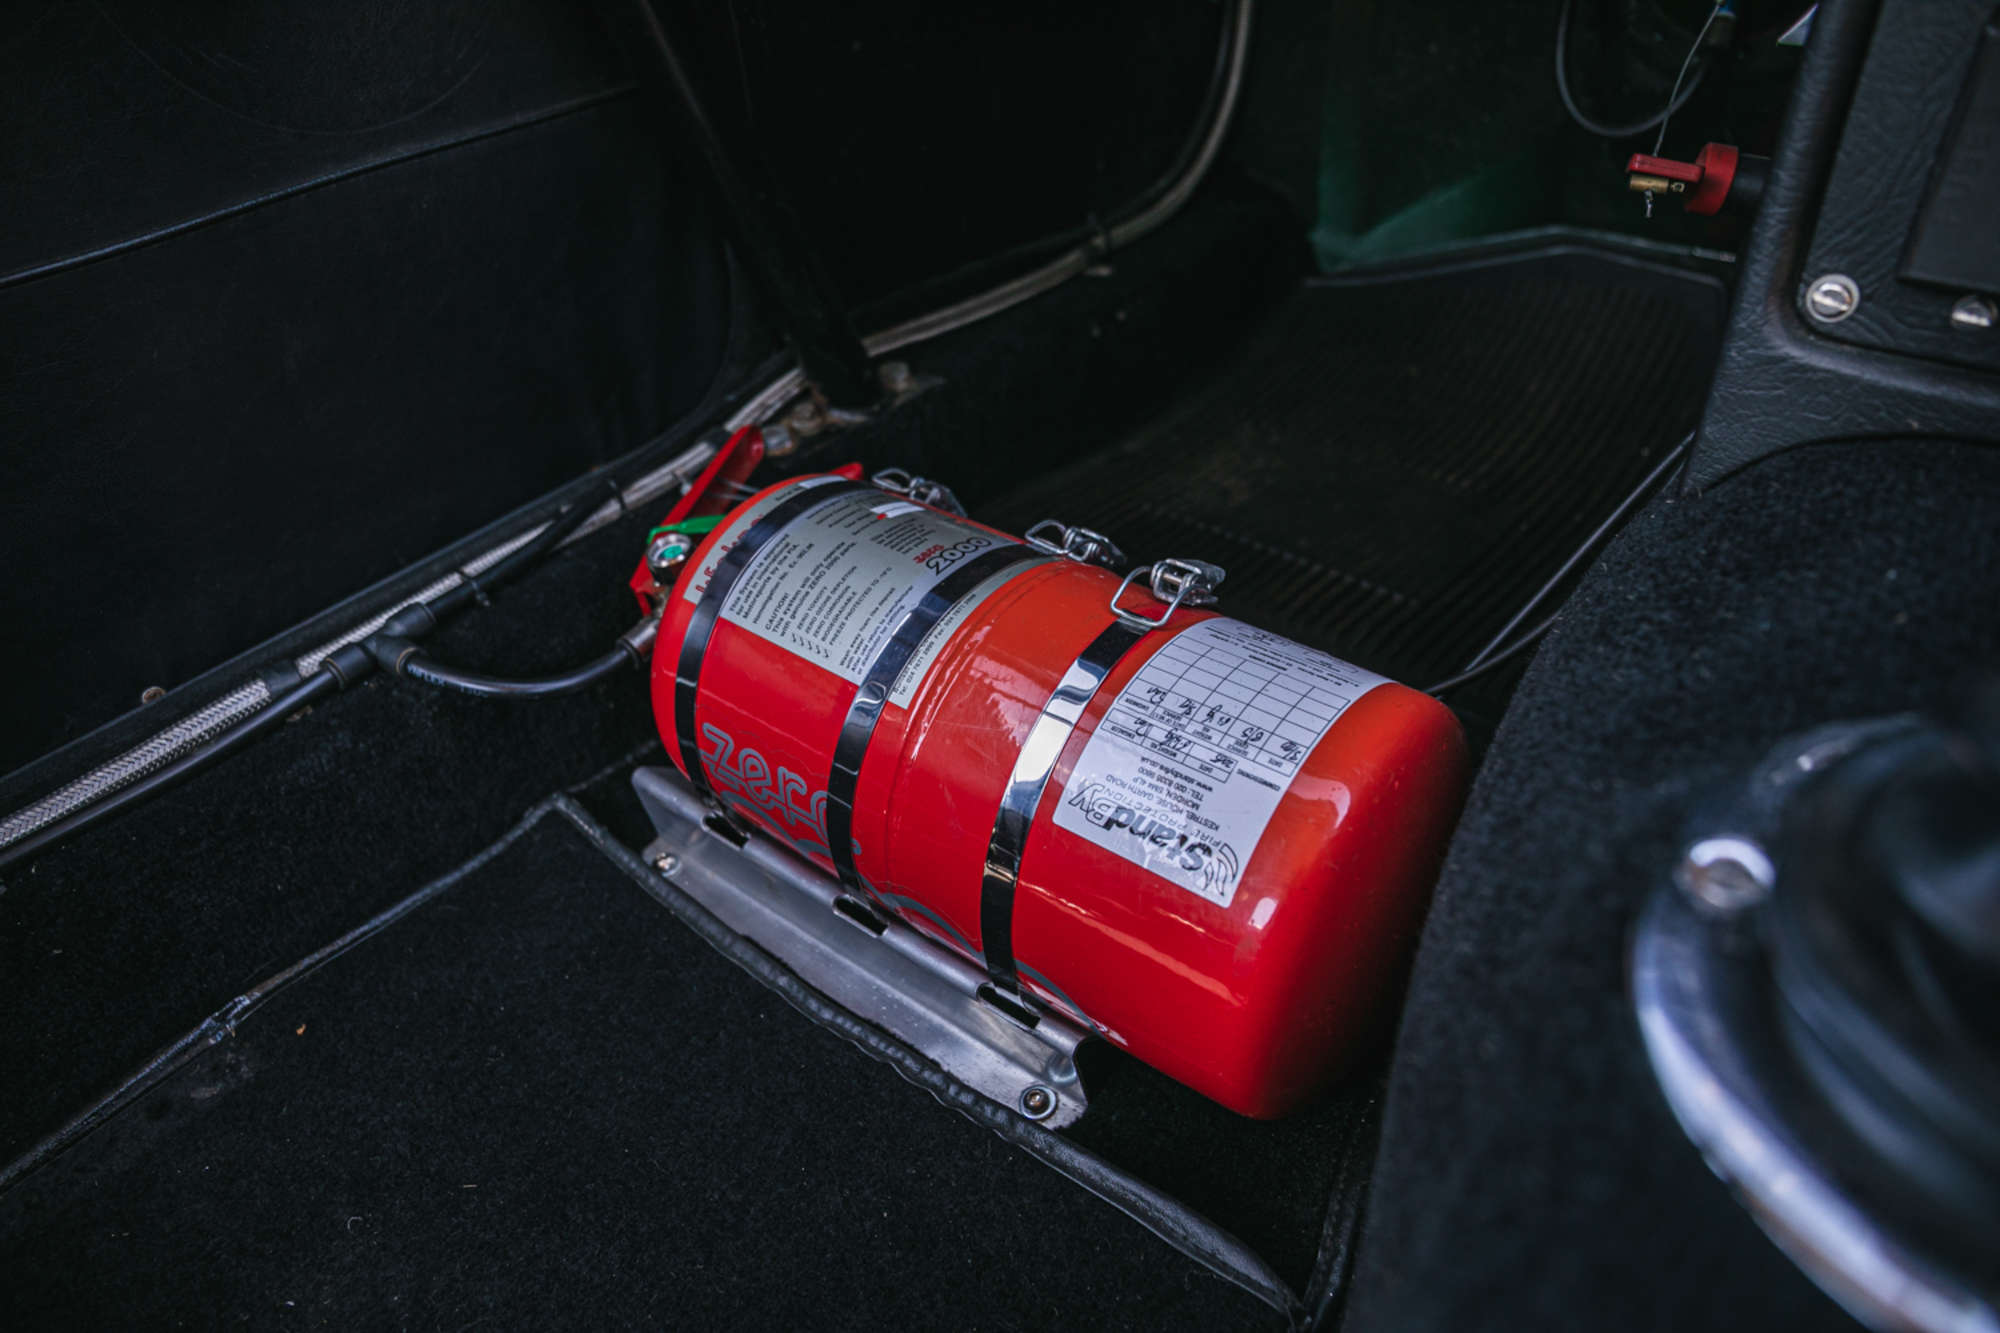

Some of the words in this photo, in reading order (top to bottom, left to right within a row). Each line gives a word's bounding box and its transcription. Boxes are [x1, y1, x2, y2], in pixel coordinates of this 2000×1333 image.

[926, 537, 992, 576] 2000
[807, 569, 826, 590] ZERO
[728, 595, 741, 611] This
[764, 591, 789, 630] CAUTION!
[770, 615, 784, 633] This
[796, 611, 809, 629] ZERO
[804, 615, 817, 633] ZERO
[812, 619, 825, 637] ZERO
[1198, 763, 1212, 773] DATE
[1267, 757, 1282, 768] DATE
[1105, 772, 1128, 789] ROAD
[1126, 783, 1154, 801] GARTH
[1101, 785, 1187, 831] PROTECTION
[1067, 783, 1213, 872] StandBy
[1183, 809, 1220, 831] KESTREL
